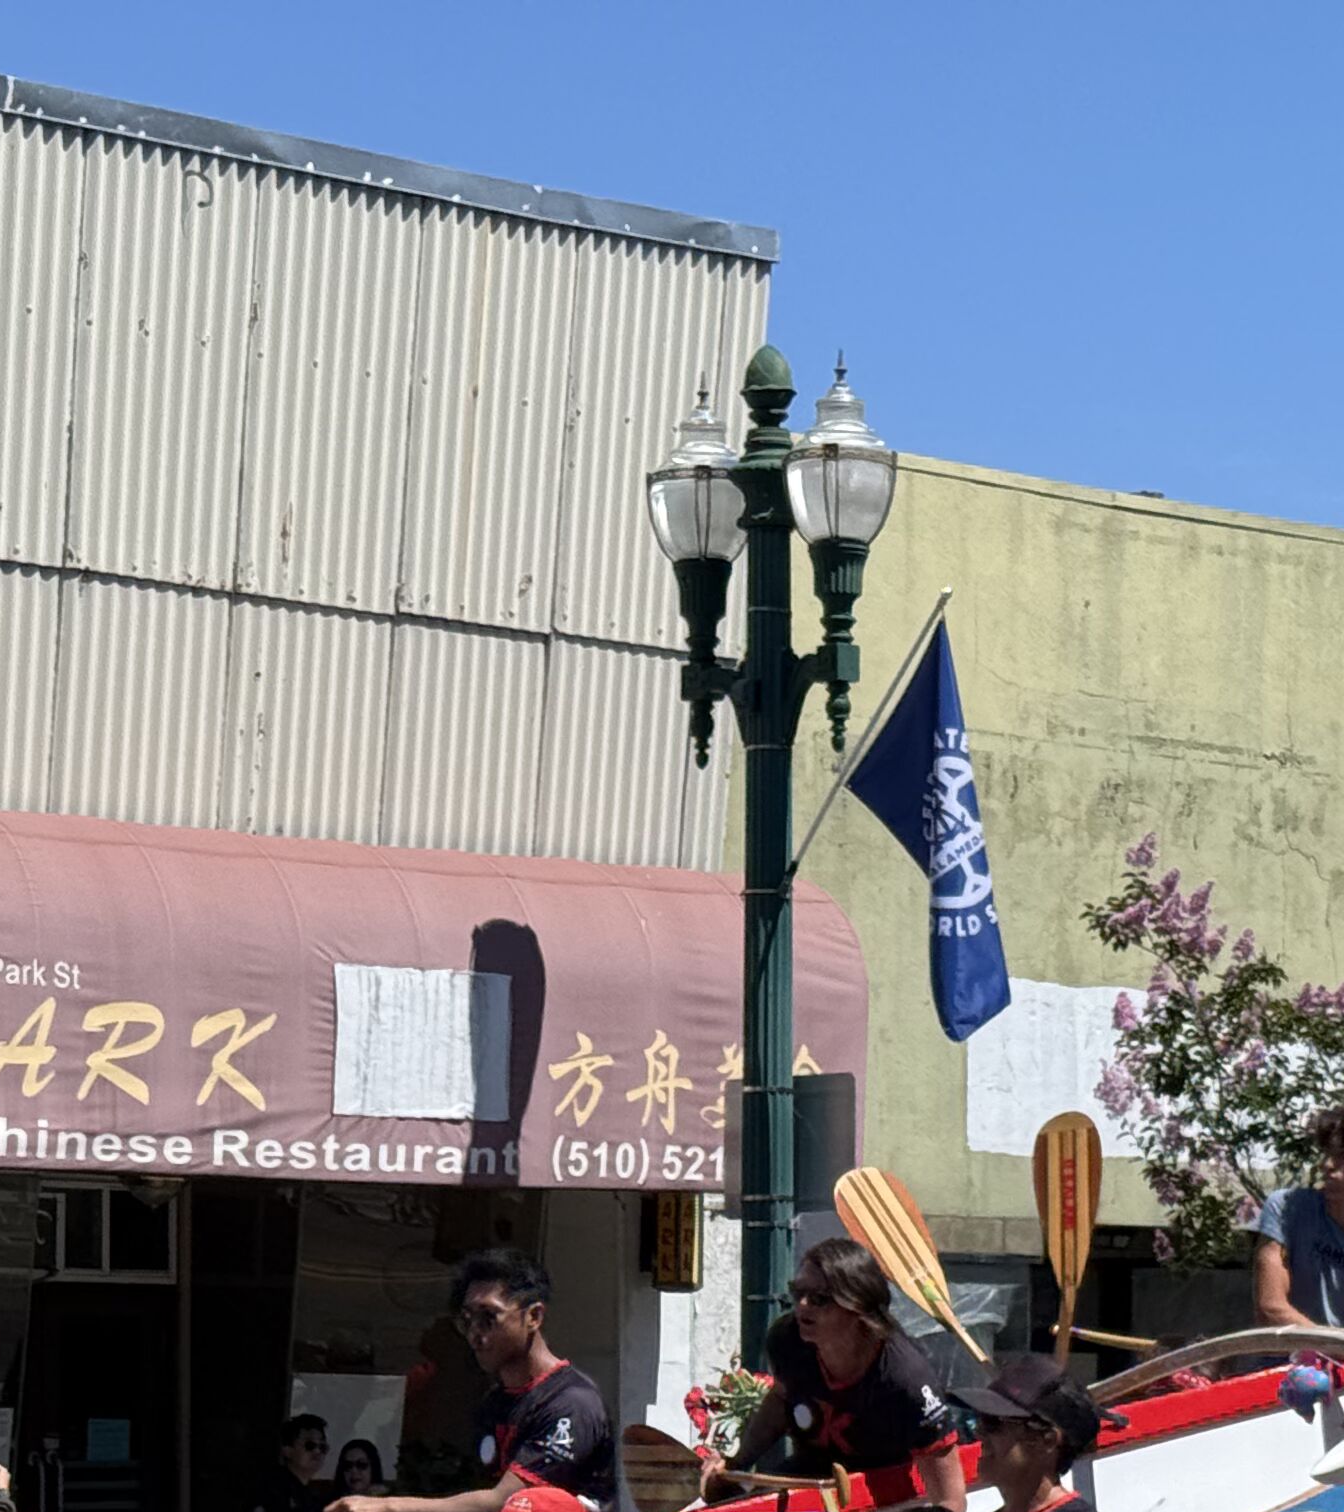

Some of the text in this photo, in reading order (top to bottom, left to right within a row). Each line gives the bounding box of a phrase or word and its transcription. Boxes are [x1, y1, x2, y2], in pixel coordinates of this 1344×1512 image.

[52, 960, 81, 990] St
[212, 1129, 519, 1177] Restaurant
[552, 1134, 725, 1186] (510) 521
